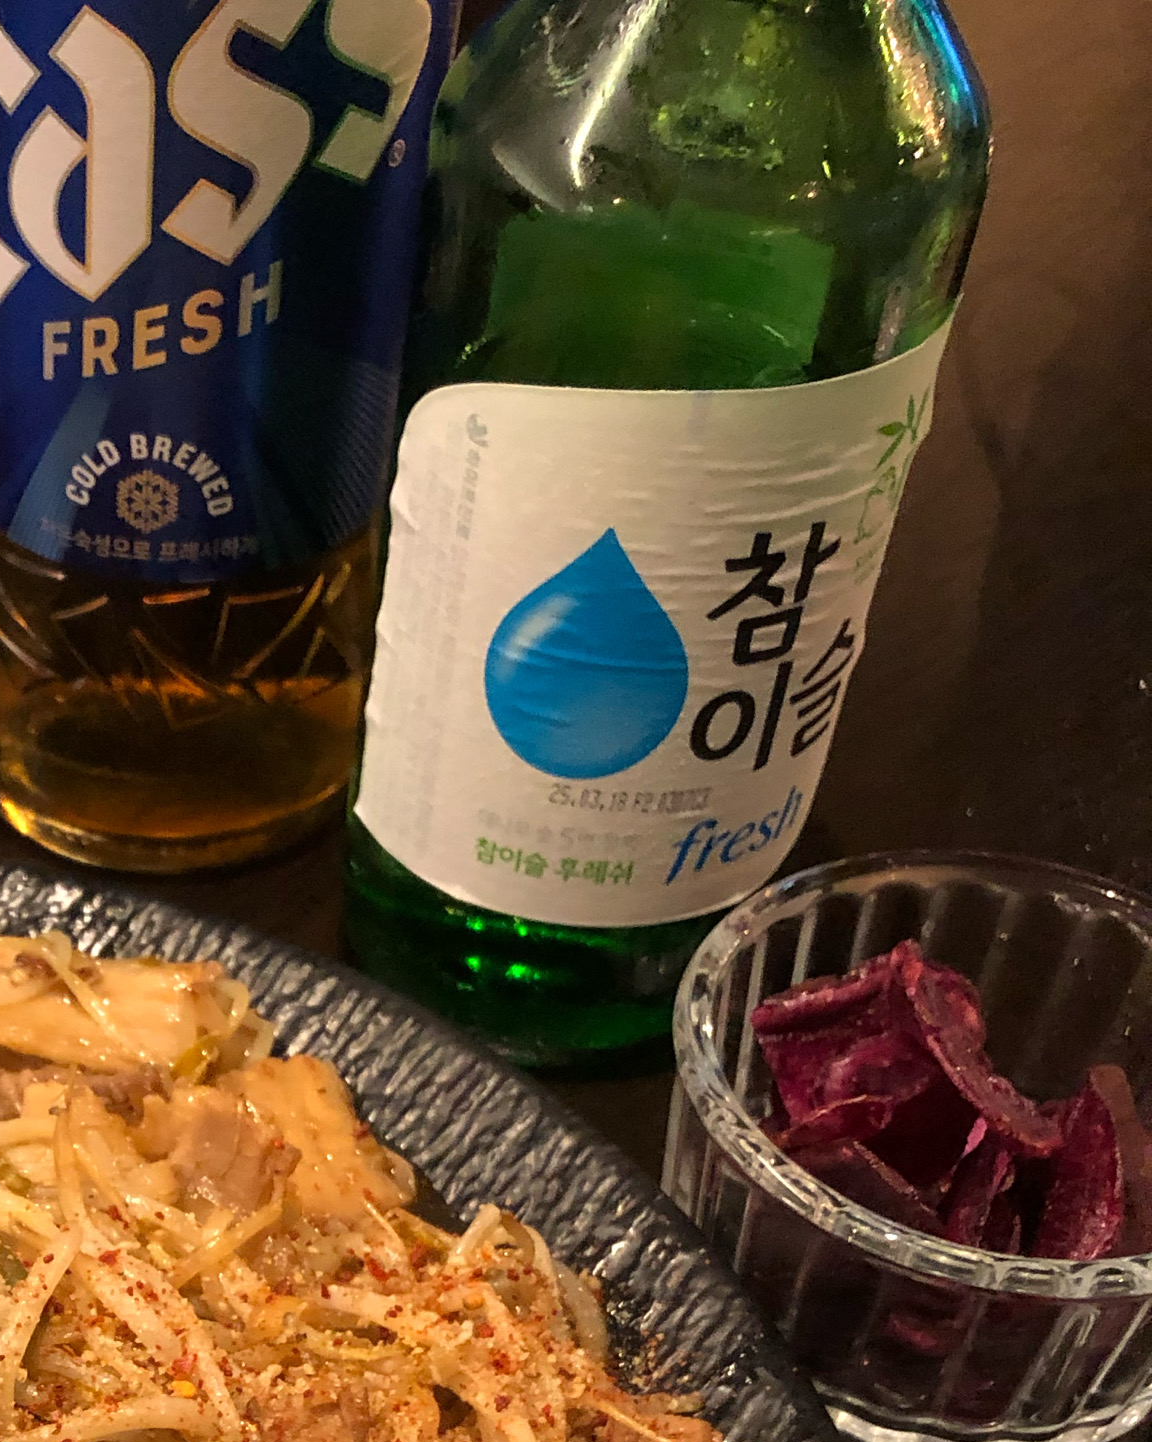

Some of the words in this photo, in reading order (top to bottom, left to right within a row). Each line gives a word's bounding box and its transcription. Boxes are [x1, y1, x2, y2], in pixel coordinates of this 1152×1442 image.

[42, 261, 284, 380] FRESH
[65, 439, 122, 506] COLD
[129, 432, 234, 518] BREWED
[476, 836, 549, 878] 참이슬
[665, 785, 804, 886] fresh
